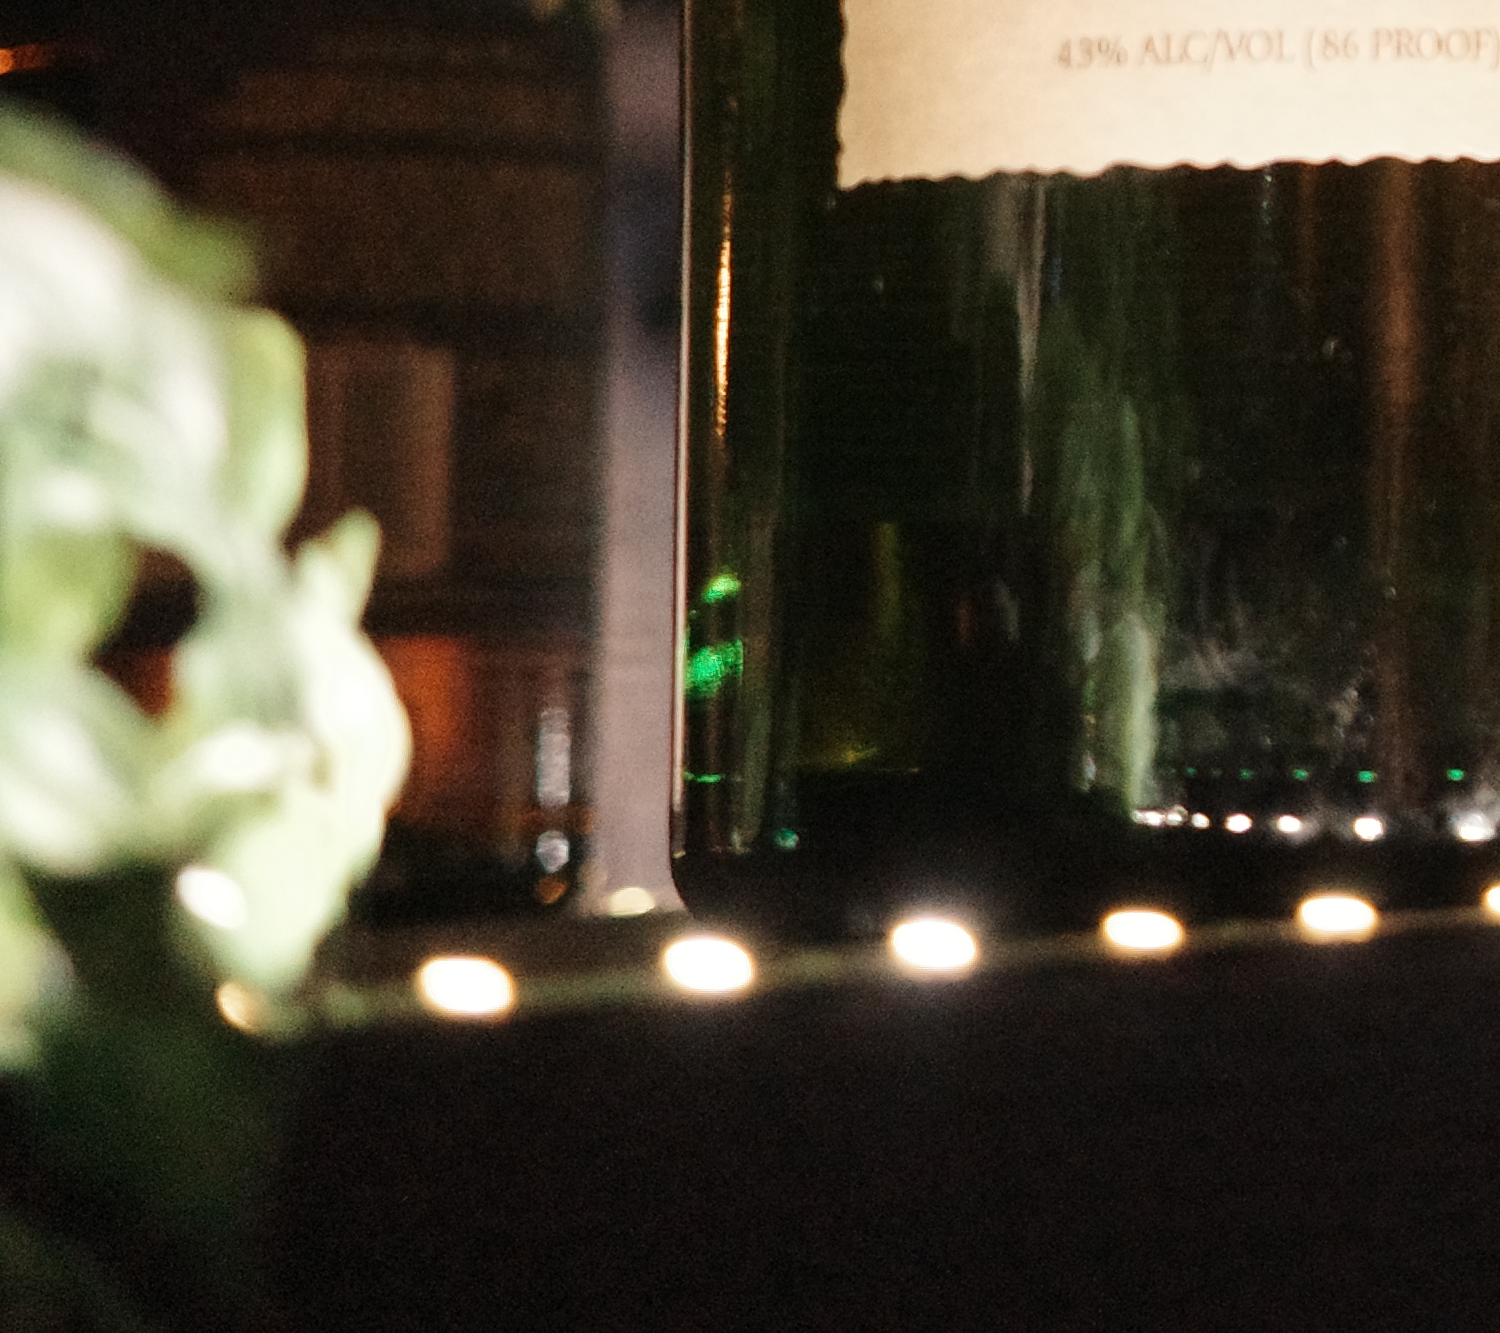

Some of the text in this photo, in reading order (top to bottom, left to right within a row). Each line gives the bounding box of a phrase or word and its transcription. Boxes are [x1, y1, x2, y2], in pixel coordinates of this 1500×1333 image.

[1057, 35, 1129, 69] 43%
[1138, 26, 1296, 73] ALC/VOL
[1305, 26, 1361, 71] (86
